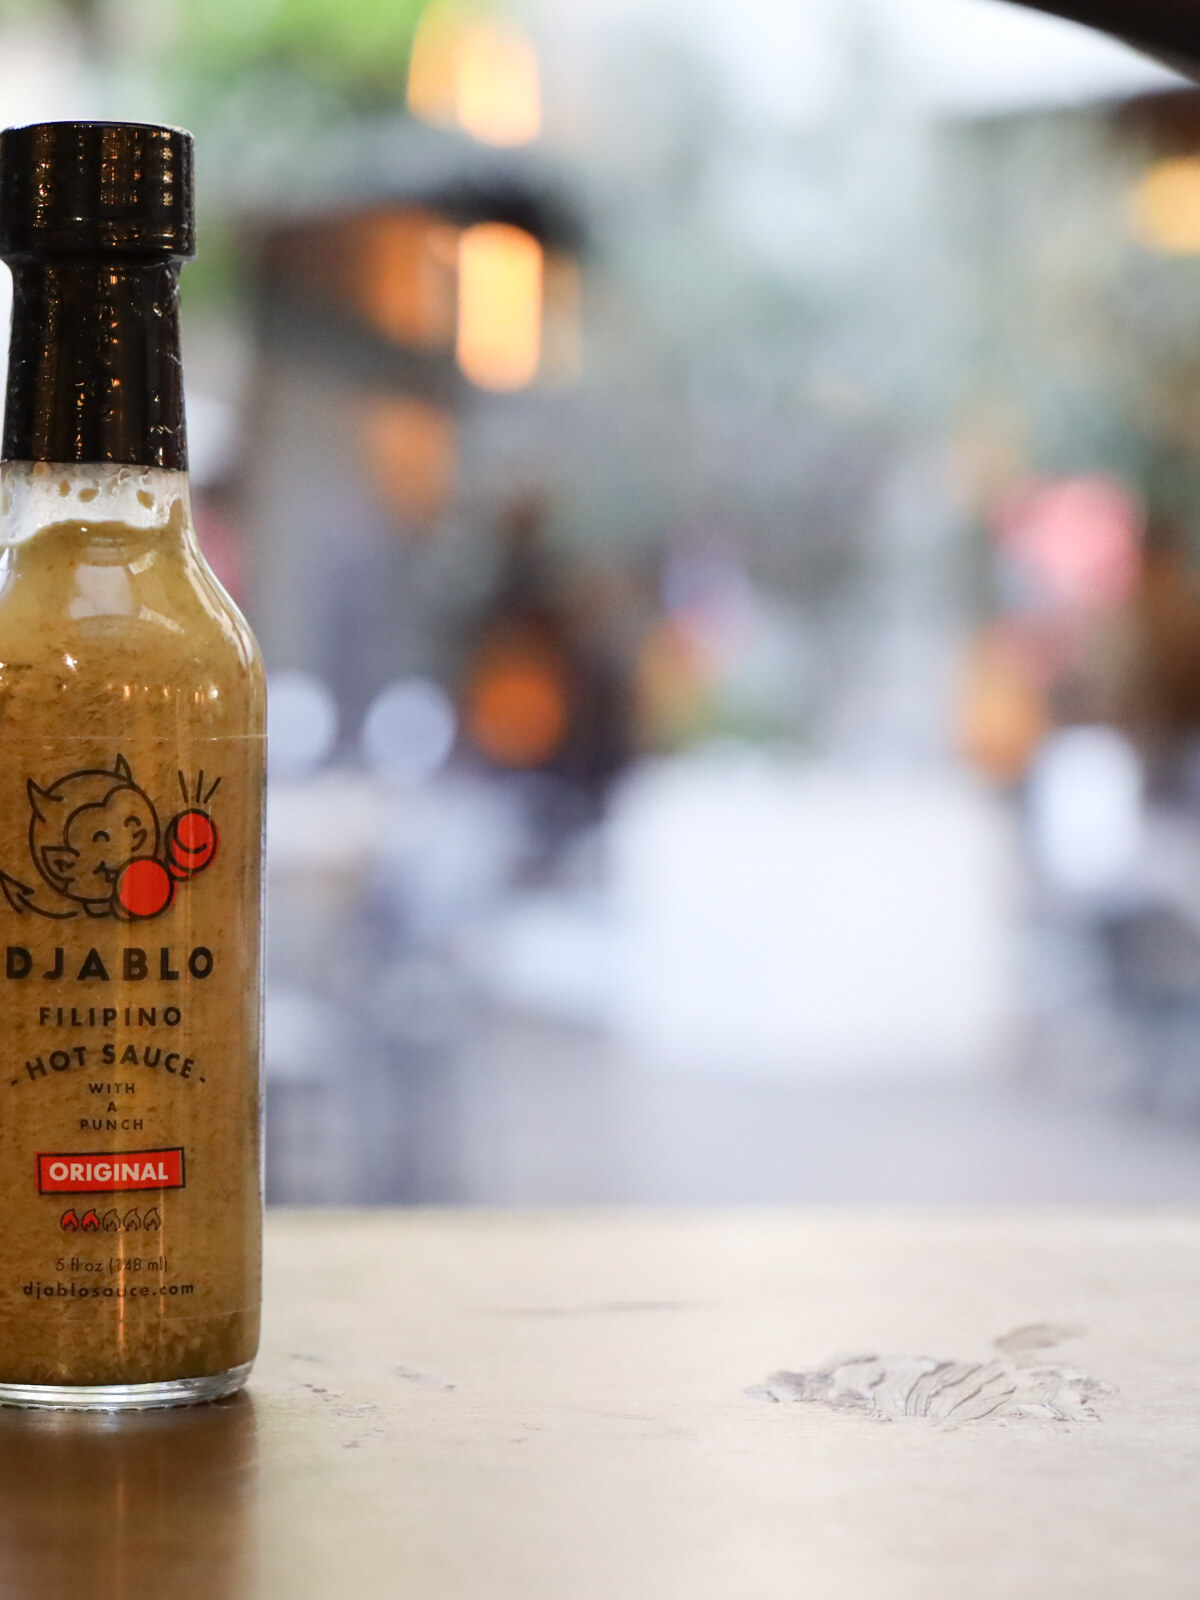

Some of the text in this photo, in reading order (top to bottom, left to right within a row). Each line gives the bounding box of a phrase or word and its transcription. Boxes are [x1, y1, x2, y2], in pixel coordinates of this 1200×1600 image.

[6, 946, 214, 981] DJABLO
[39, 1006, 182, 1027] FILIPINO
[24, 1043, 195, 1081] HOT SAUCE
[89, 1083, 136, 1094] WITH
[106, 1101, 117, 1112] A
[80, 1119, 144, 1131] PUNCH
[49, 1161, 169, 1182] ORIGINAL
[55, 1258, 65, 1271] 5
[70, 1257, 80, 1271] fl
[85, 1261, 103, 1272] oz
[23, 1281, 195, 1299] djablosauce.com
